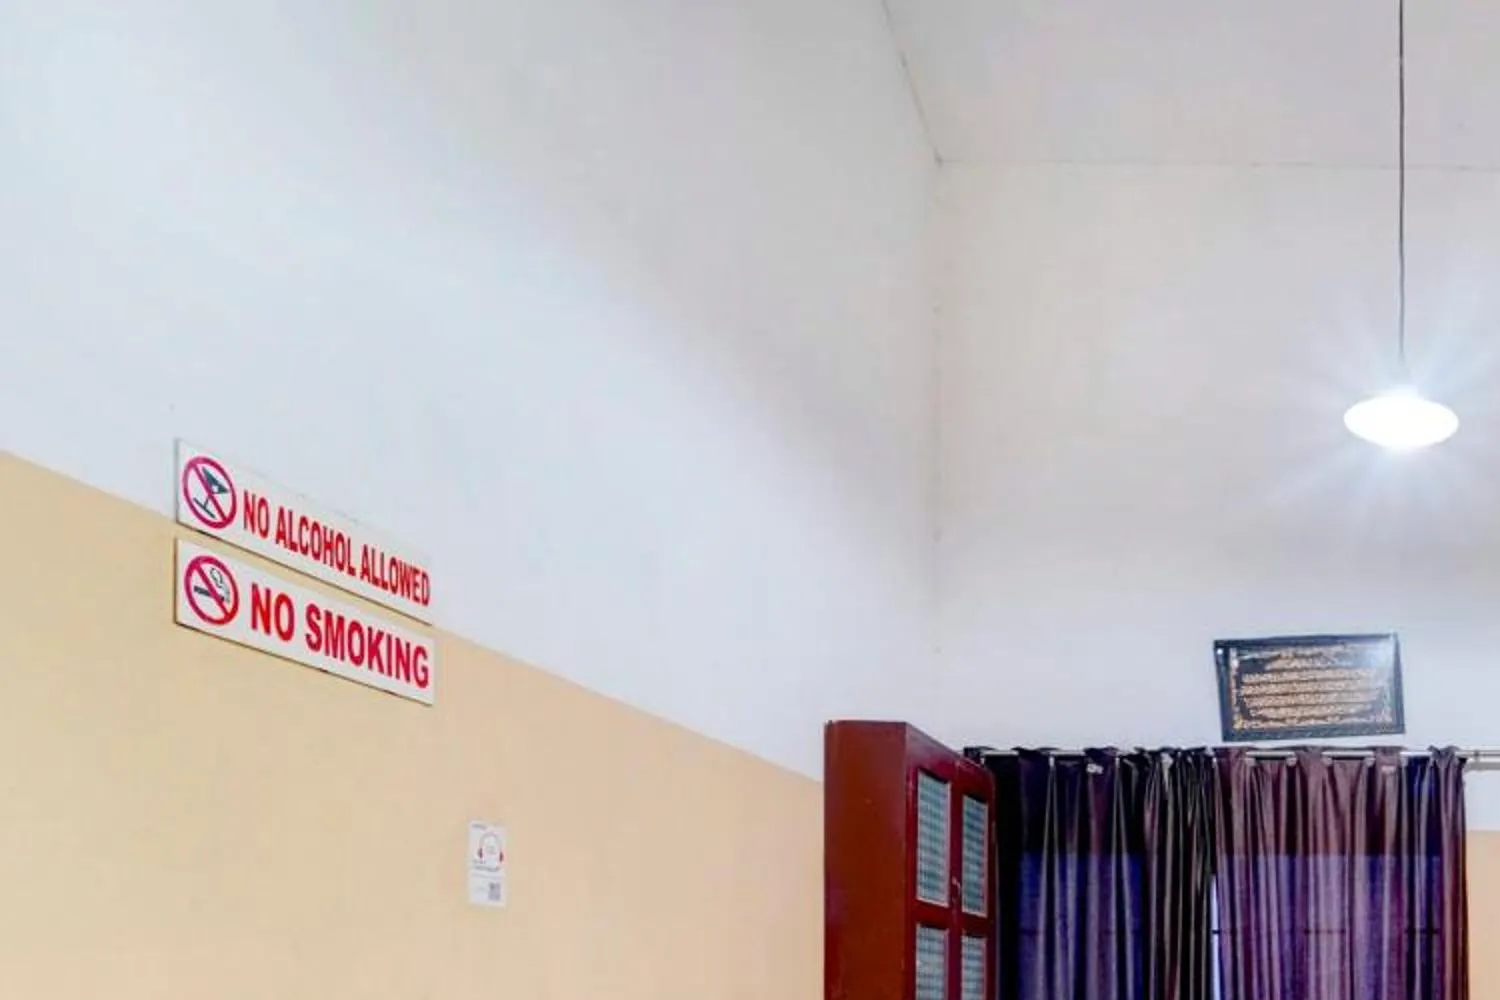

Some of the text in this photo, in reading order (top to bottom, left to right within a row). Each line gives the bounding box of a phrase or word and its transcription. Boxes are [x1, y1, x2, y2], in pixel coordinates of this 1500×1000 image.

[242, 490, 431, 607] NO ALCOHOL ALLOWED
[250, 583, 430, 689] NO SMOKING
